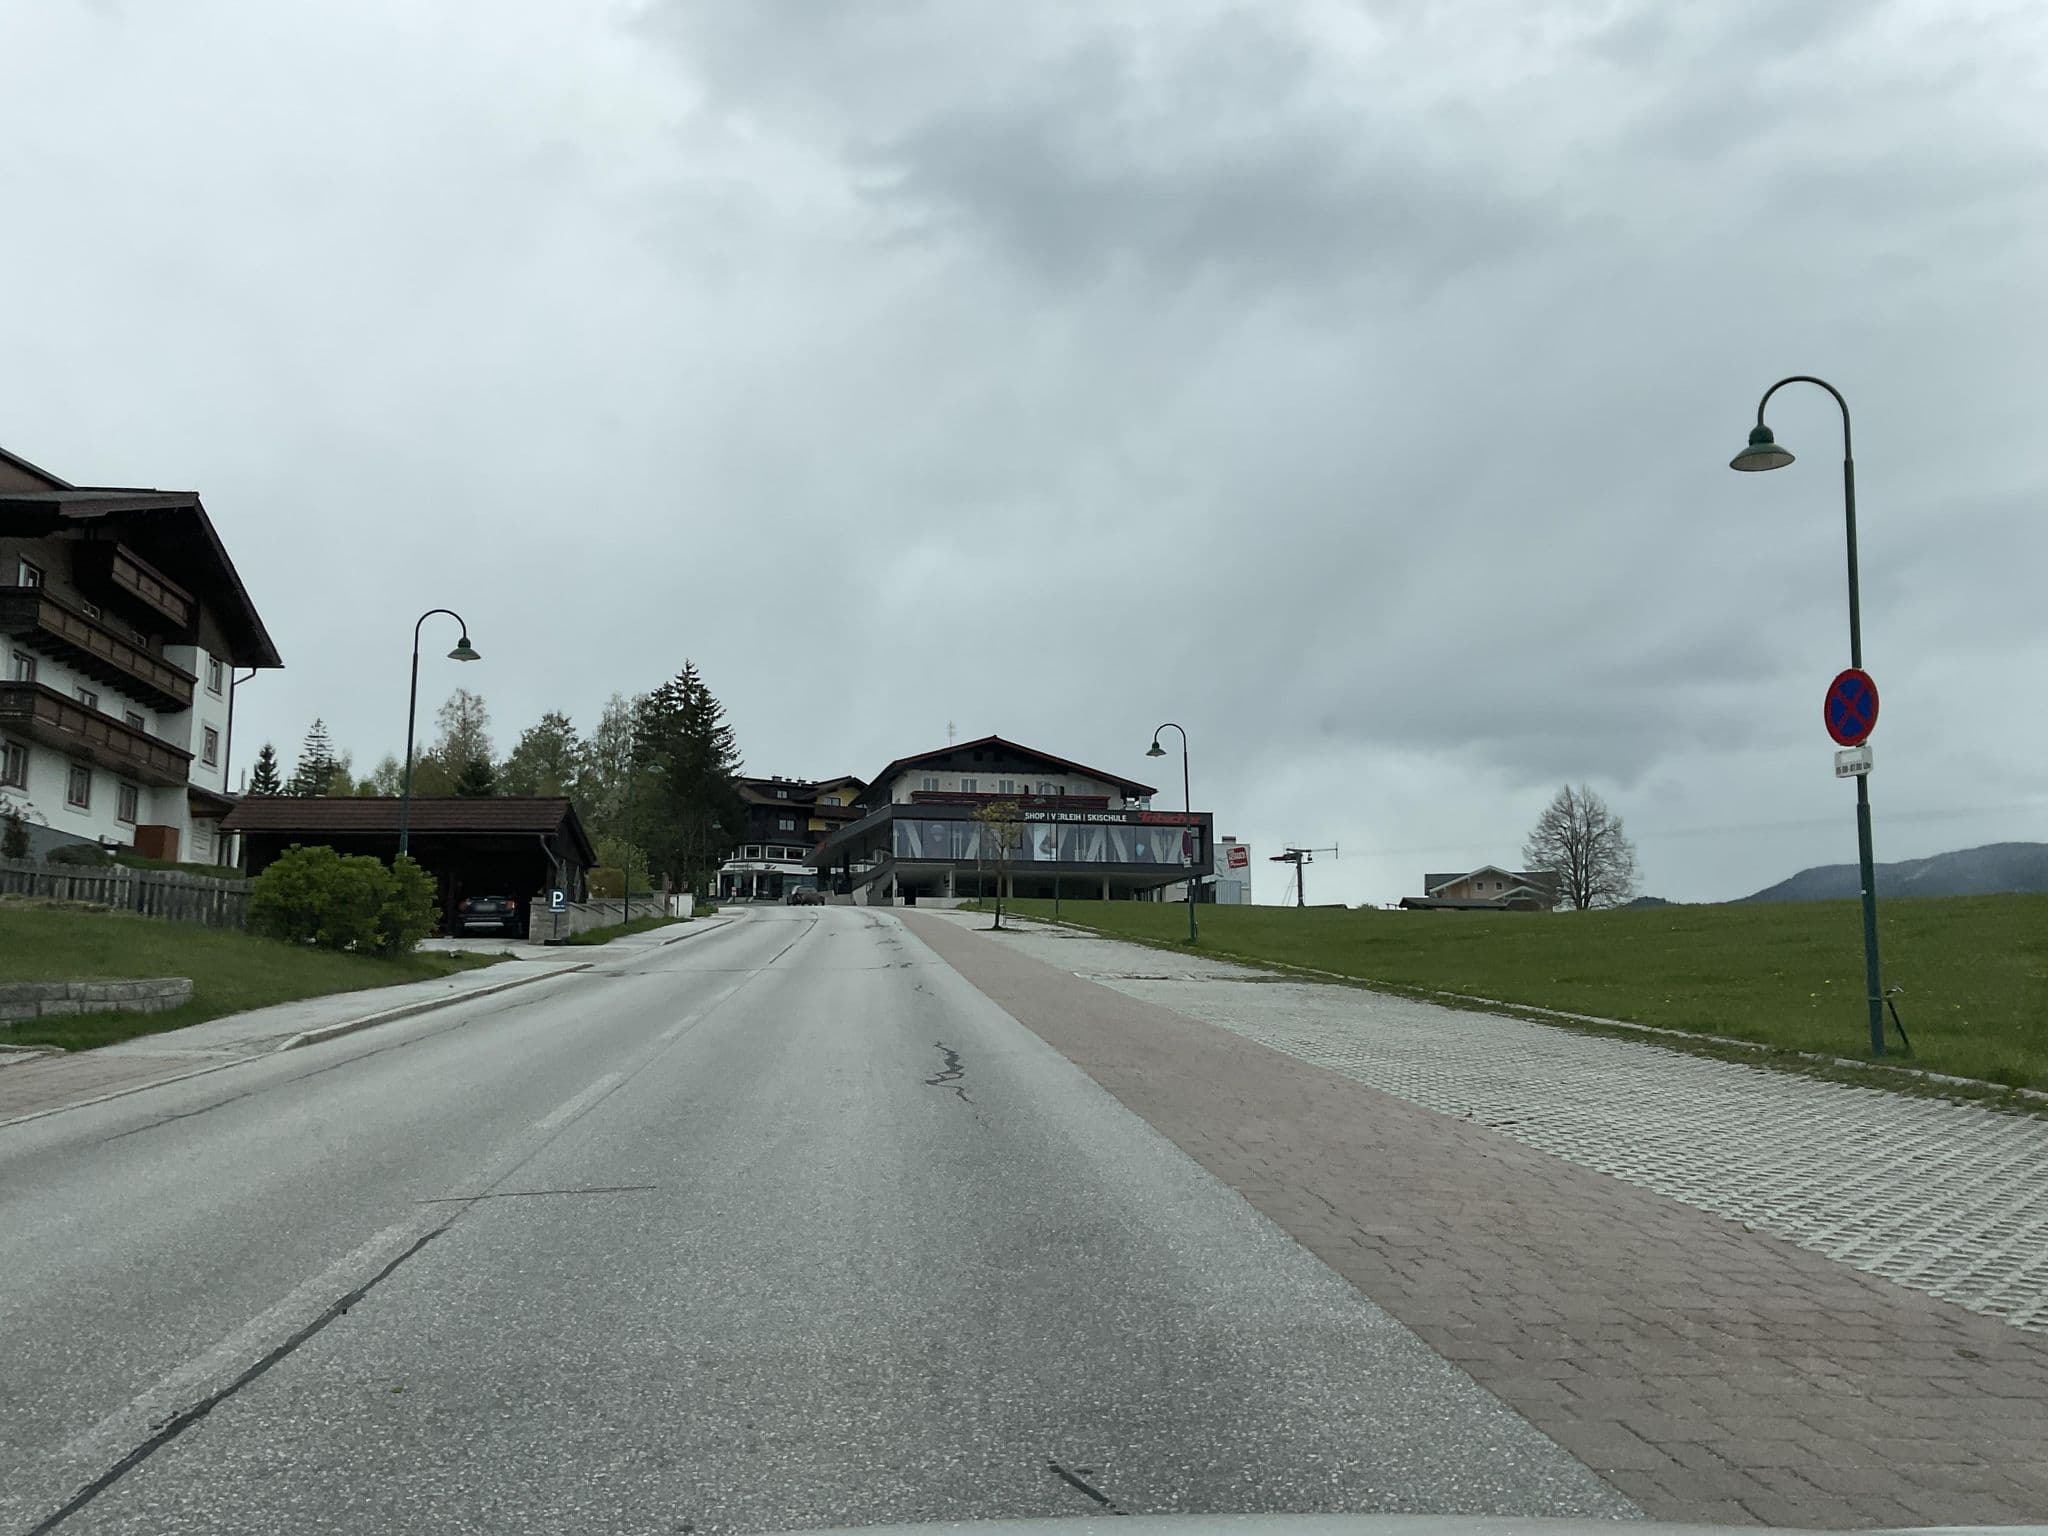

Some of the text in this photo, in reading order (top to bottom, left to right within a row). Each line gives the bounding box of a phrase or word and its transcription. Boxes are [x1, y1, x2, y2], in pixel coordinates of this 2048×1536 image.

[1025, 812, 1045, 820] SHOP
[1088, 814, 1127, 822] SKISCHULE
[552, 891, 563, 907] P
